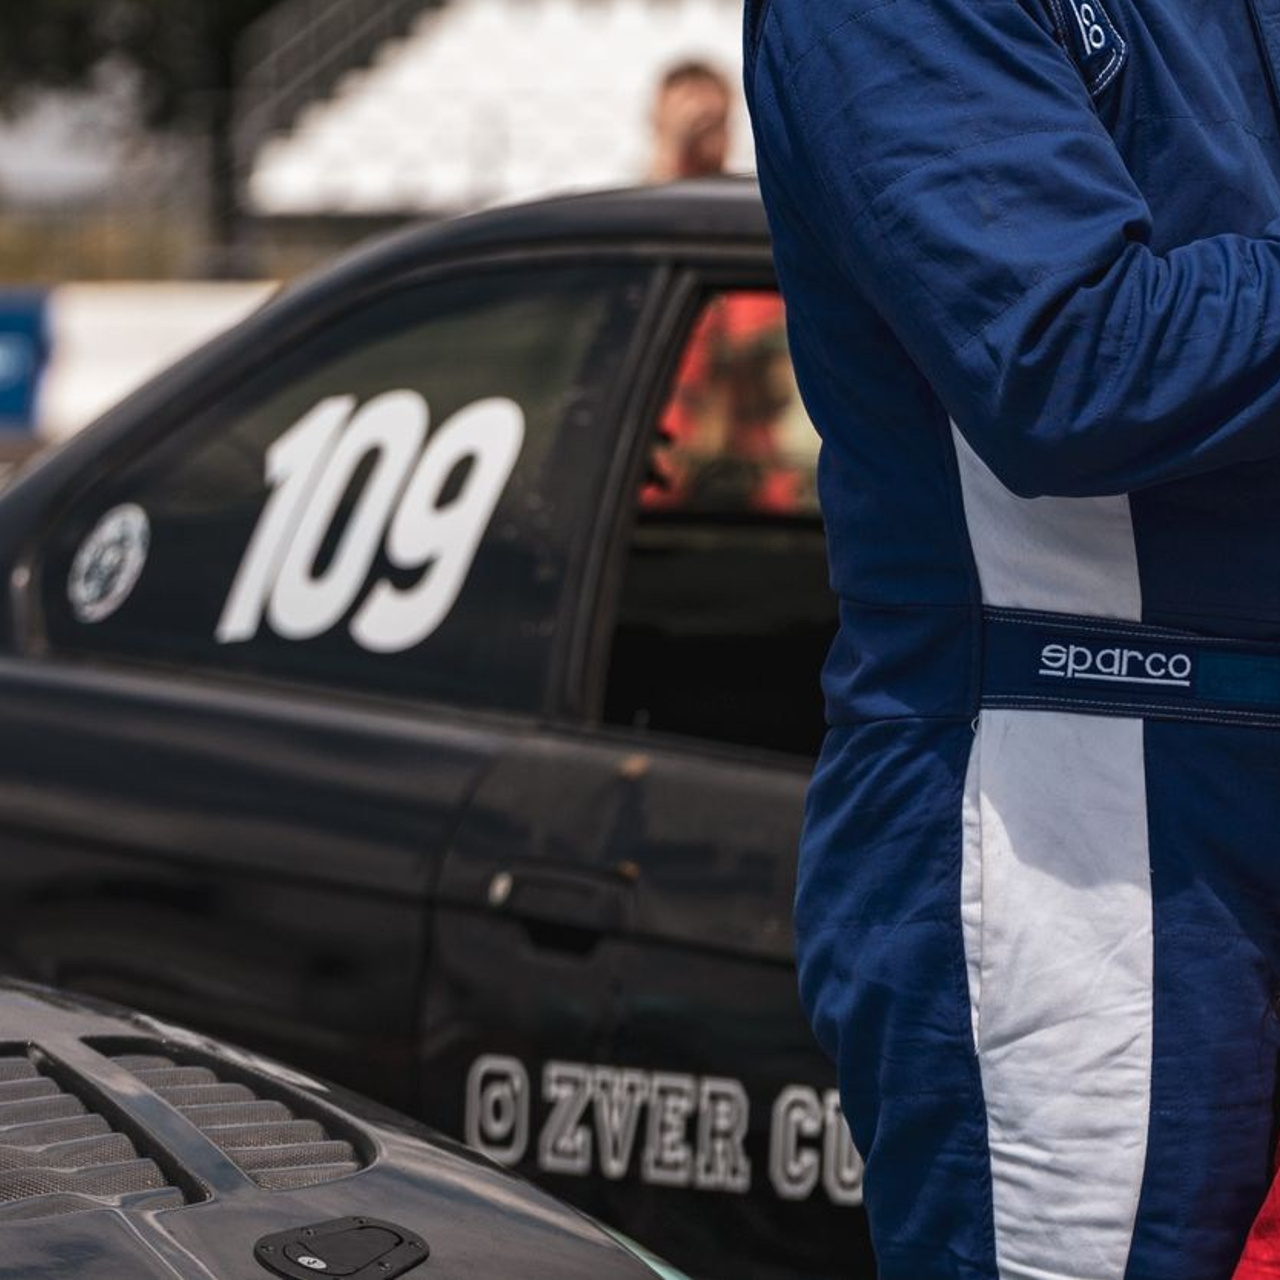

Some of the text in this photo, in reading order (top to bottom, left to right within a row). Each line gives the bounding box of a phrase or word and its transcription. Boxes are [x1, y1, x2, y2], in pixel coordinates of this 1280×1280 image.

[215, 388, 526, 653] 109
[1039, 643, 1192, 685] sparco
[538, 1060, 751, 1193] ZVER
